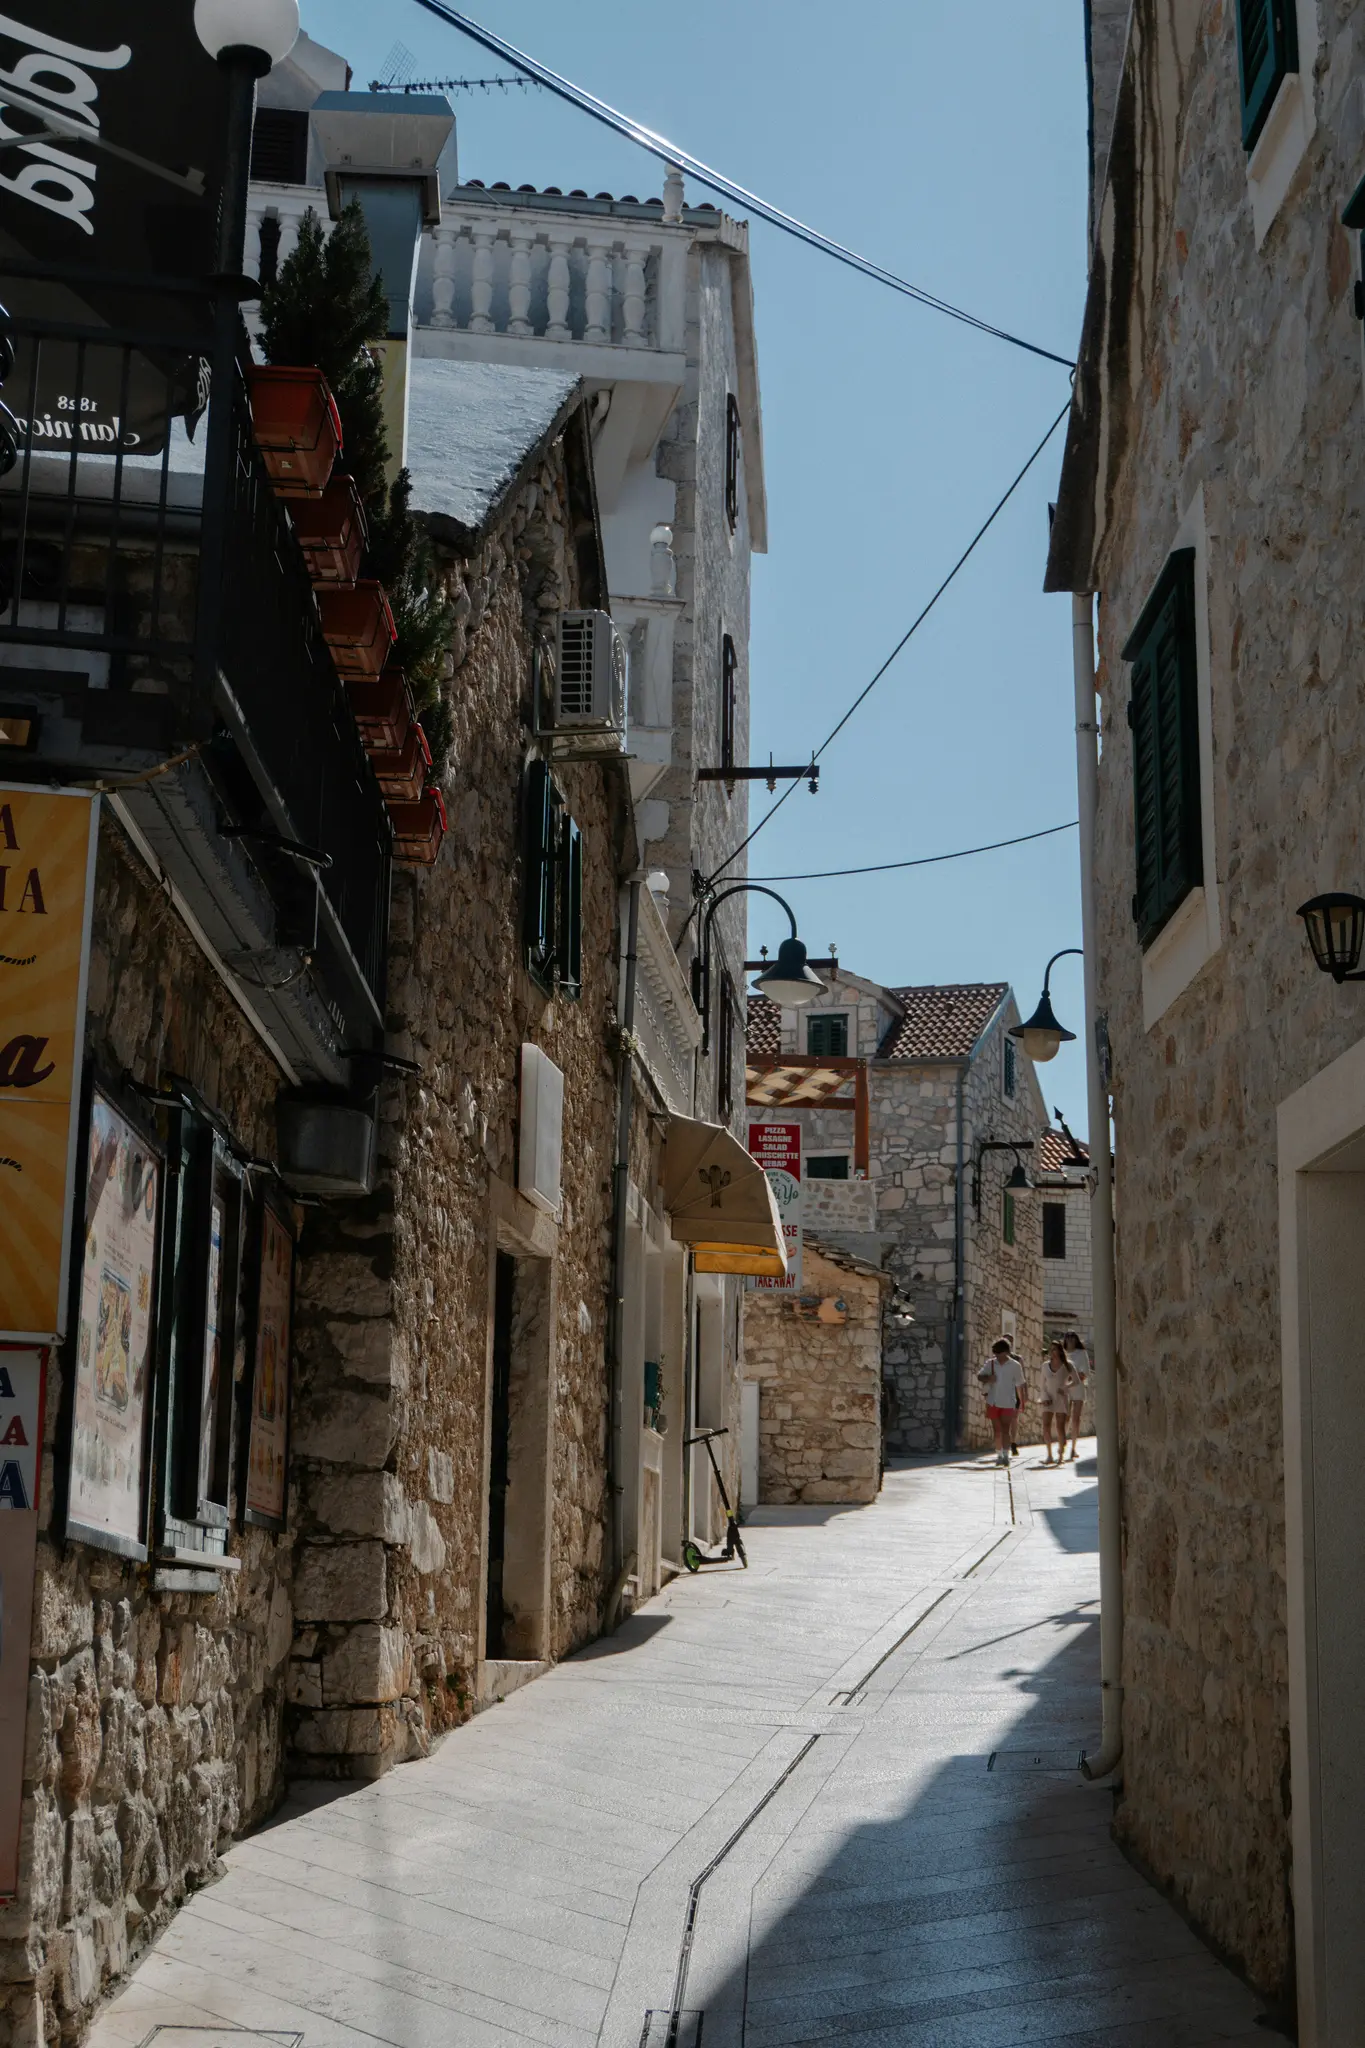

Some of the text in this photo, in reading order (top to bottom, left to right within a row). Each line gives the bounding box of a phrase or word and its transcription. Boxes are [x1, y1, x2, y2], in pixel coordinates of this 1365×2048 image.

[764, 1126, 786, 1134] PIZZA
[758, 1135, 792, 1143] LASAGNE
[762, 1143, 788, 1151] SALAD
[751, 1152, 799, 1160] BRUSCHETTE
